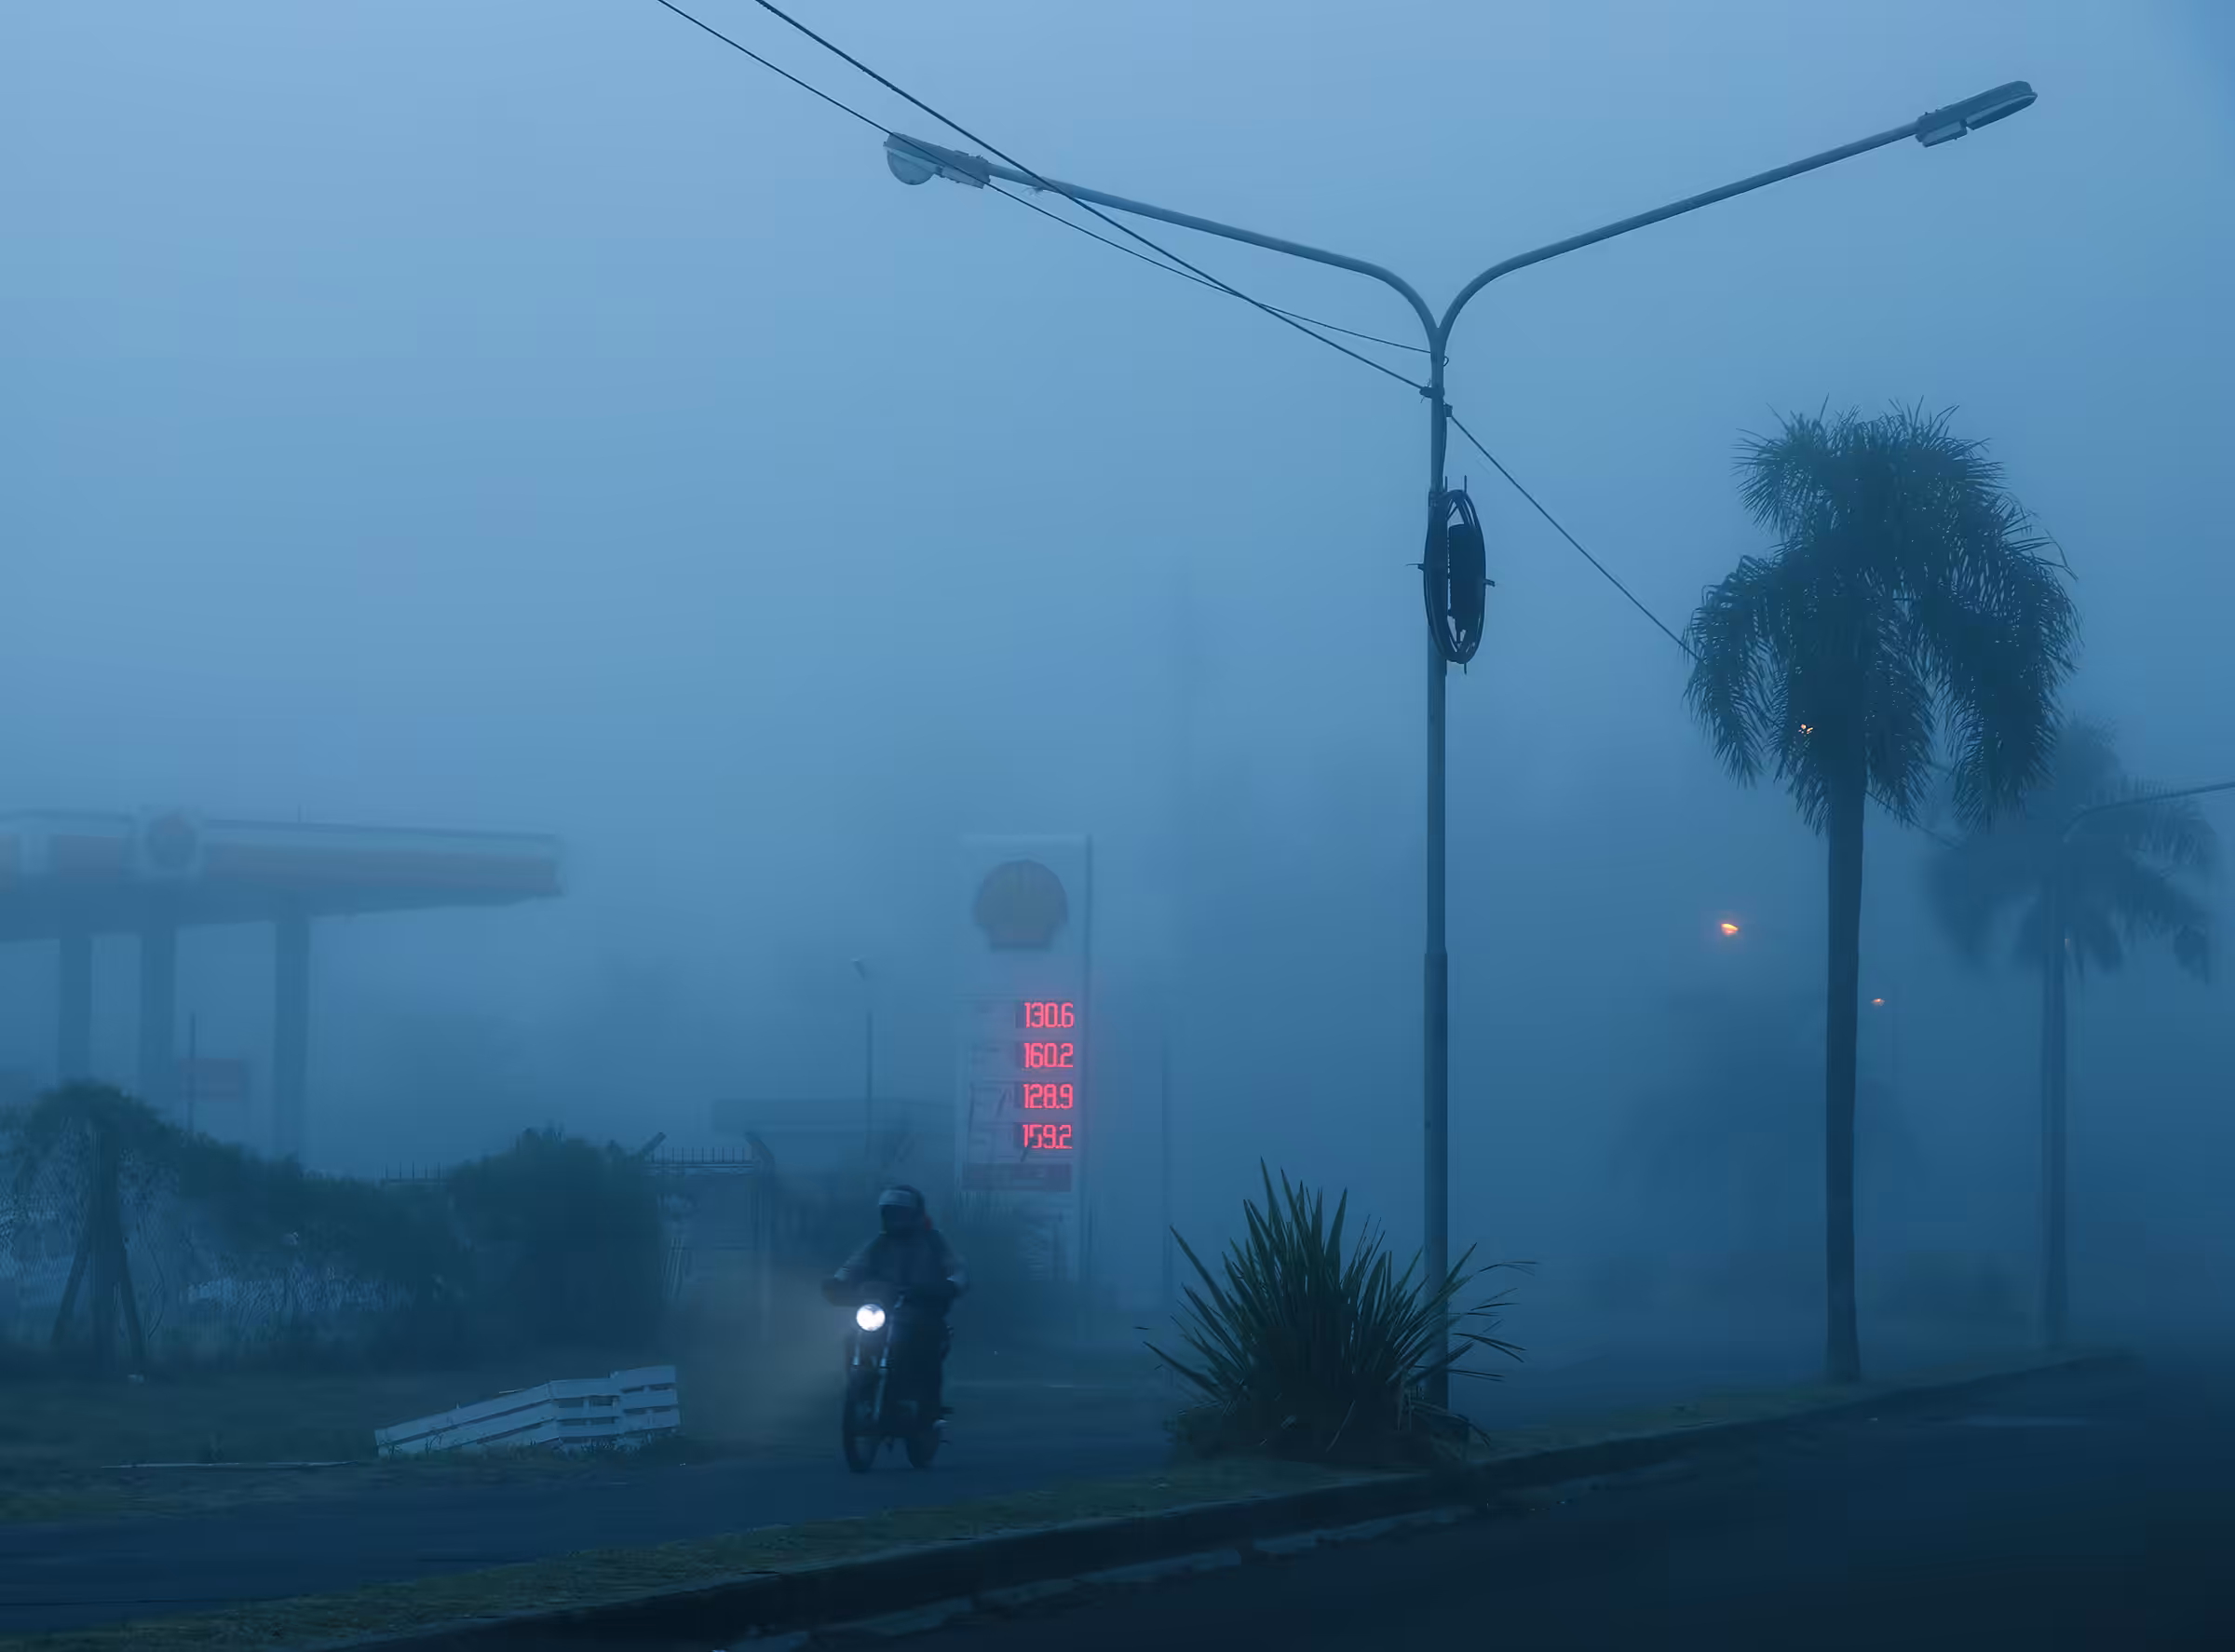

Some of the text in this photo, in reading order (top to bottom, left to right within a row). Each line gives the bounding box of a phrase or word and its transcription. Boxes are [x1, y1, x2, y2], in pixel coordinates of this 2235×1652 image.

[1023, 1002, 1074, 1028] 130.6
[1023, 1042, 1073, 1068] 160.2
[1023, 1083, 1073, 1109] 128.9
